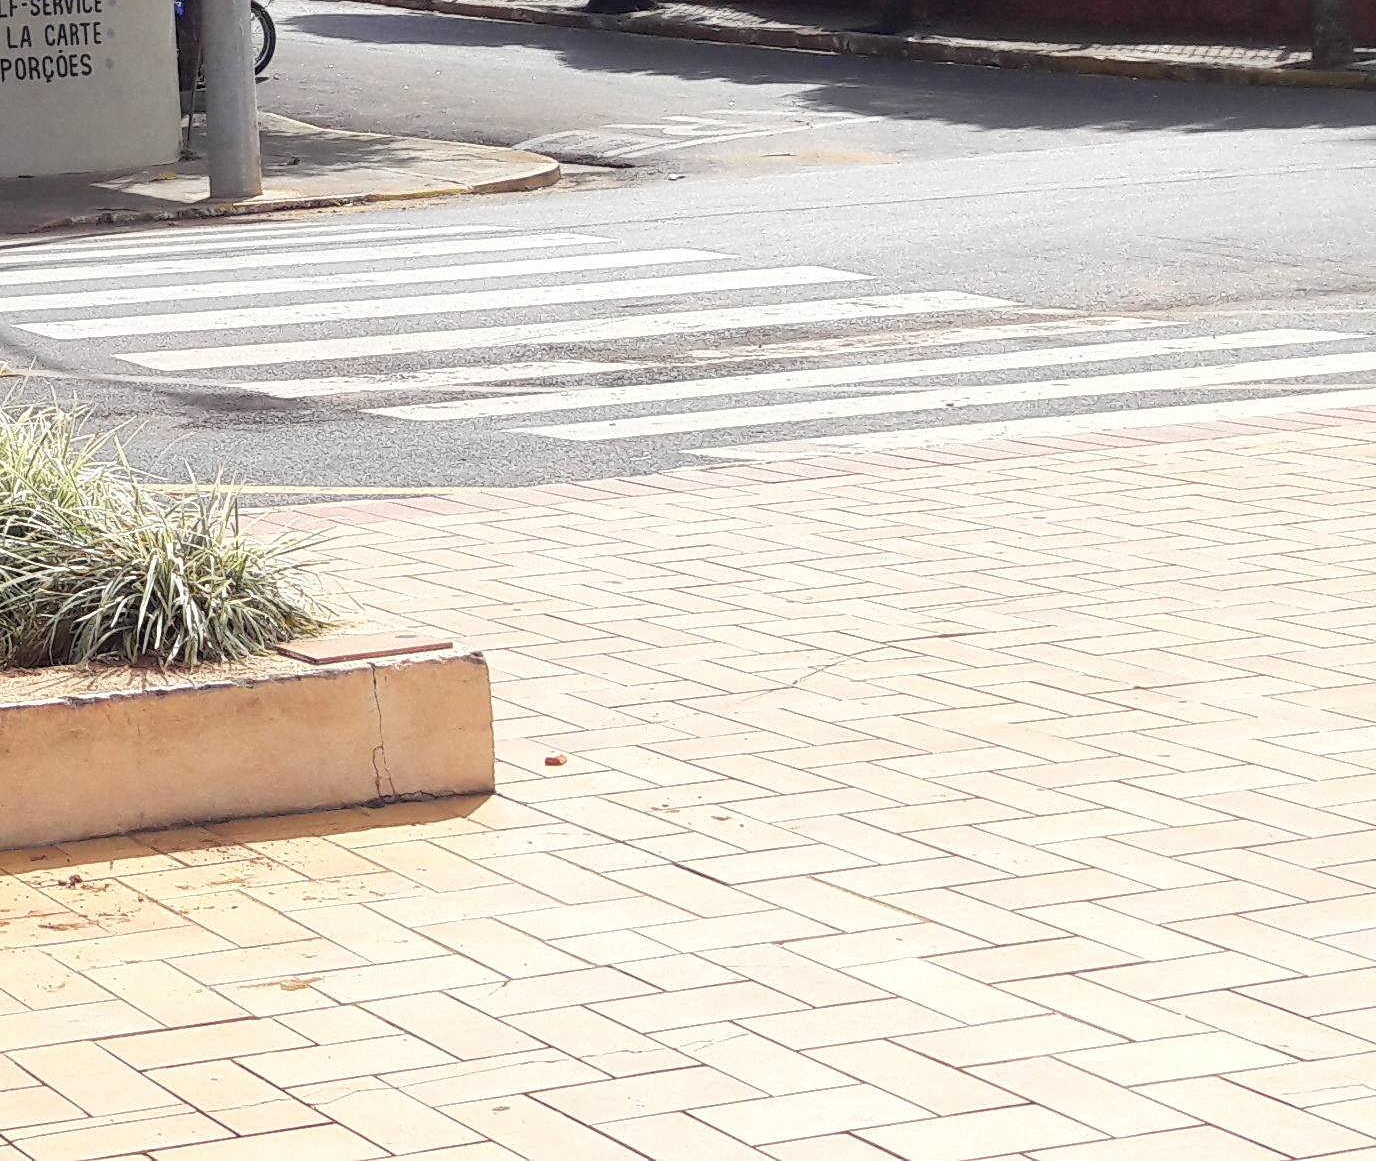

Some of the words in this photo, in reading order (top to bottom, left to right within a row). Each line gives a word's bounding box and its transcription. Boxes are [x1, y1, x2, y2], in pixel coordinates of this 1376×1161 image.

[6, 25, 32, 49] LA
[44, 21, 102, 47] CARTE
[0, 49, 93, 83] PORÇÕES
